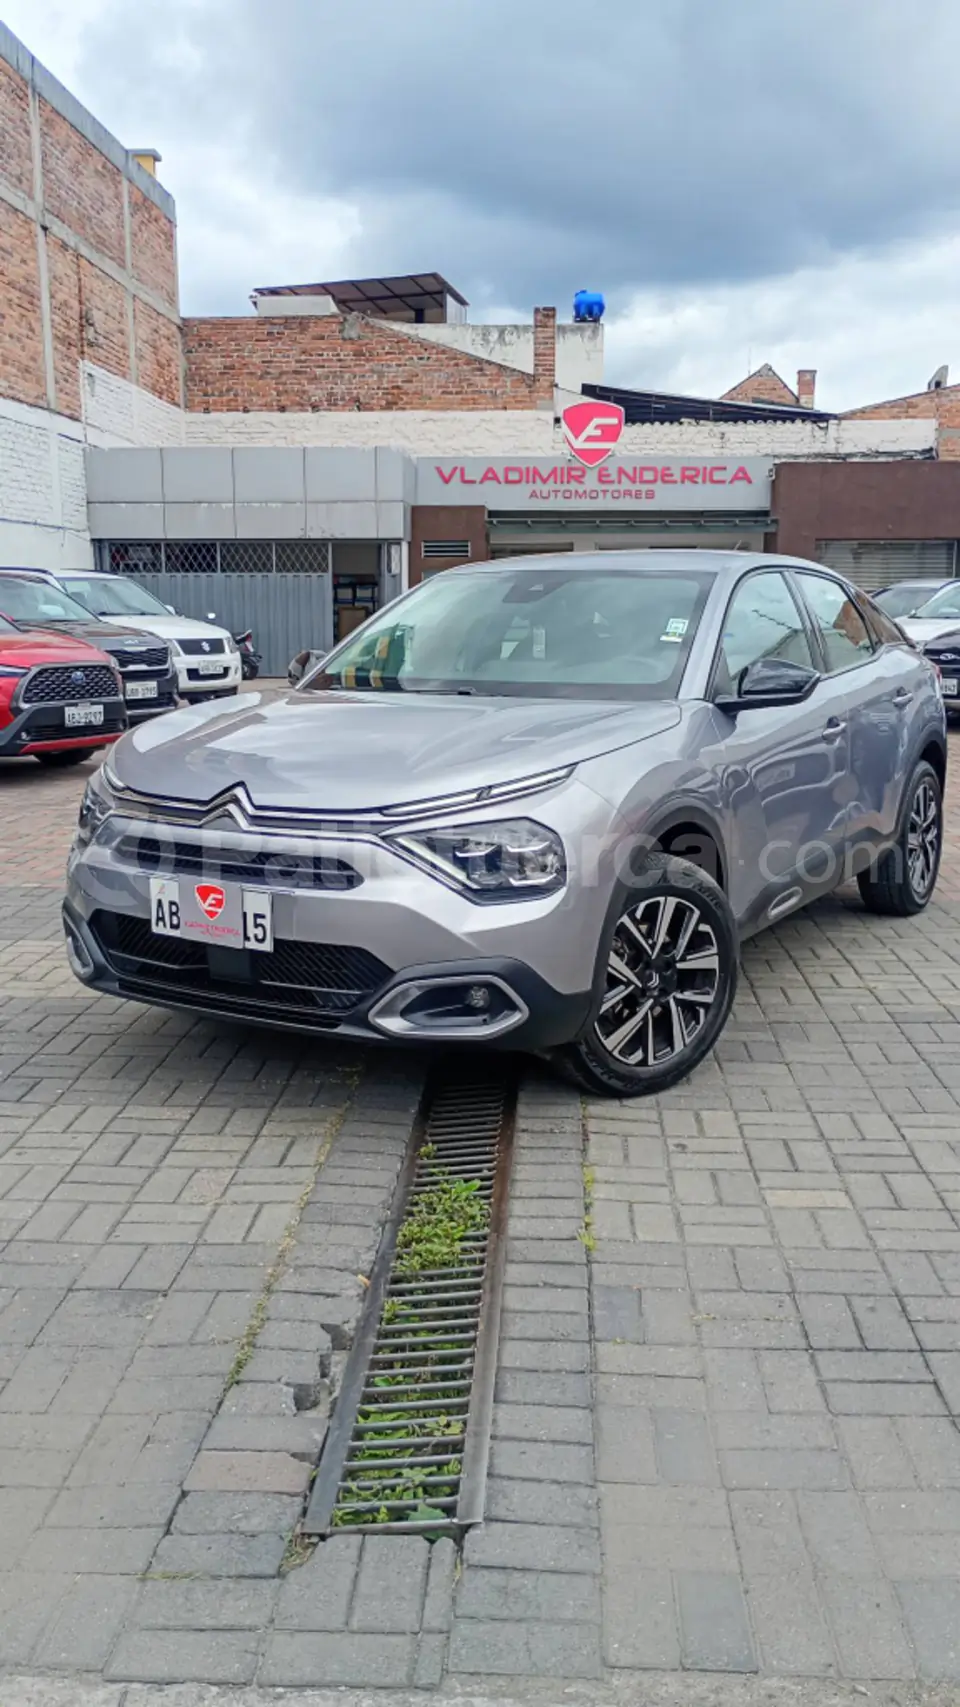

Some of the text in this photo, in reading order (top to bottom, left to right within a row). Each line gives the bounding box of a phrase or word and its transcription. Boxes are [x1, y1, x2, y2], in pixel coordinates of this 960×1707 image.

[435, 466, 753, 485] VLADIMIR ENDERICA
[529, 489, 656, 500] AUTOMOTORES
[155, 898, 181, 931] AB
